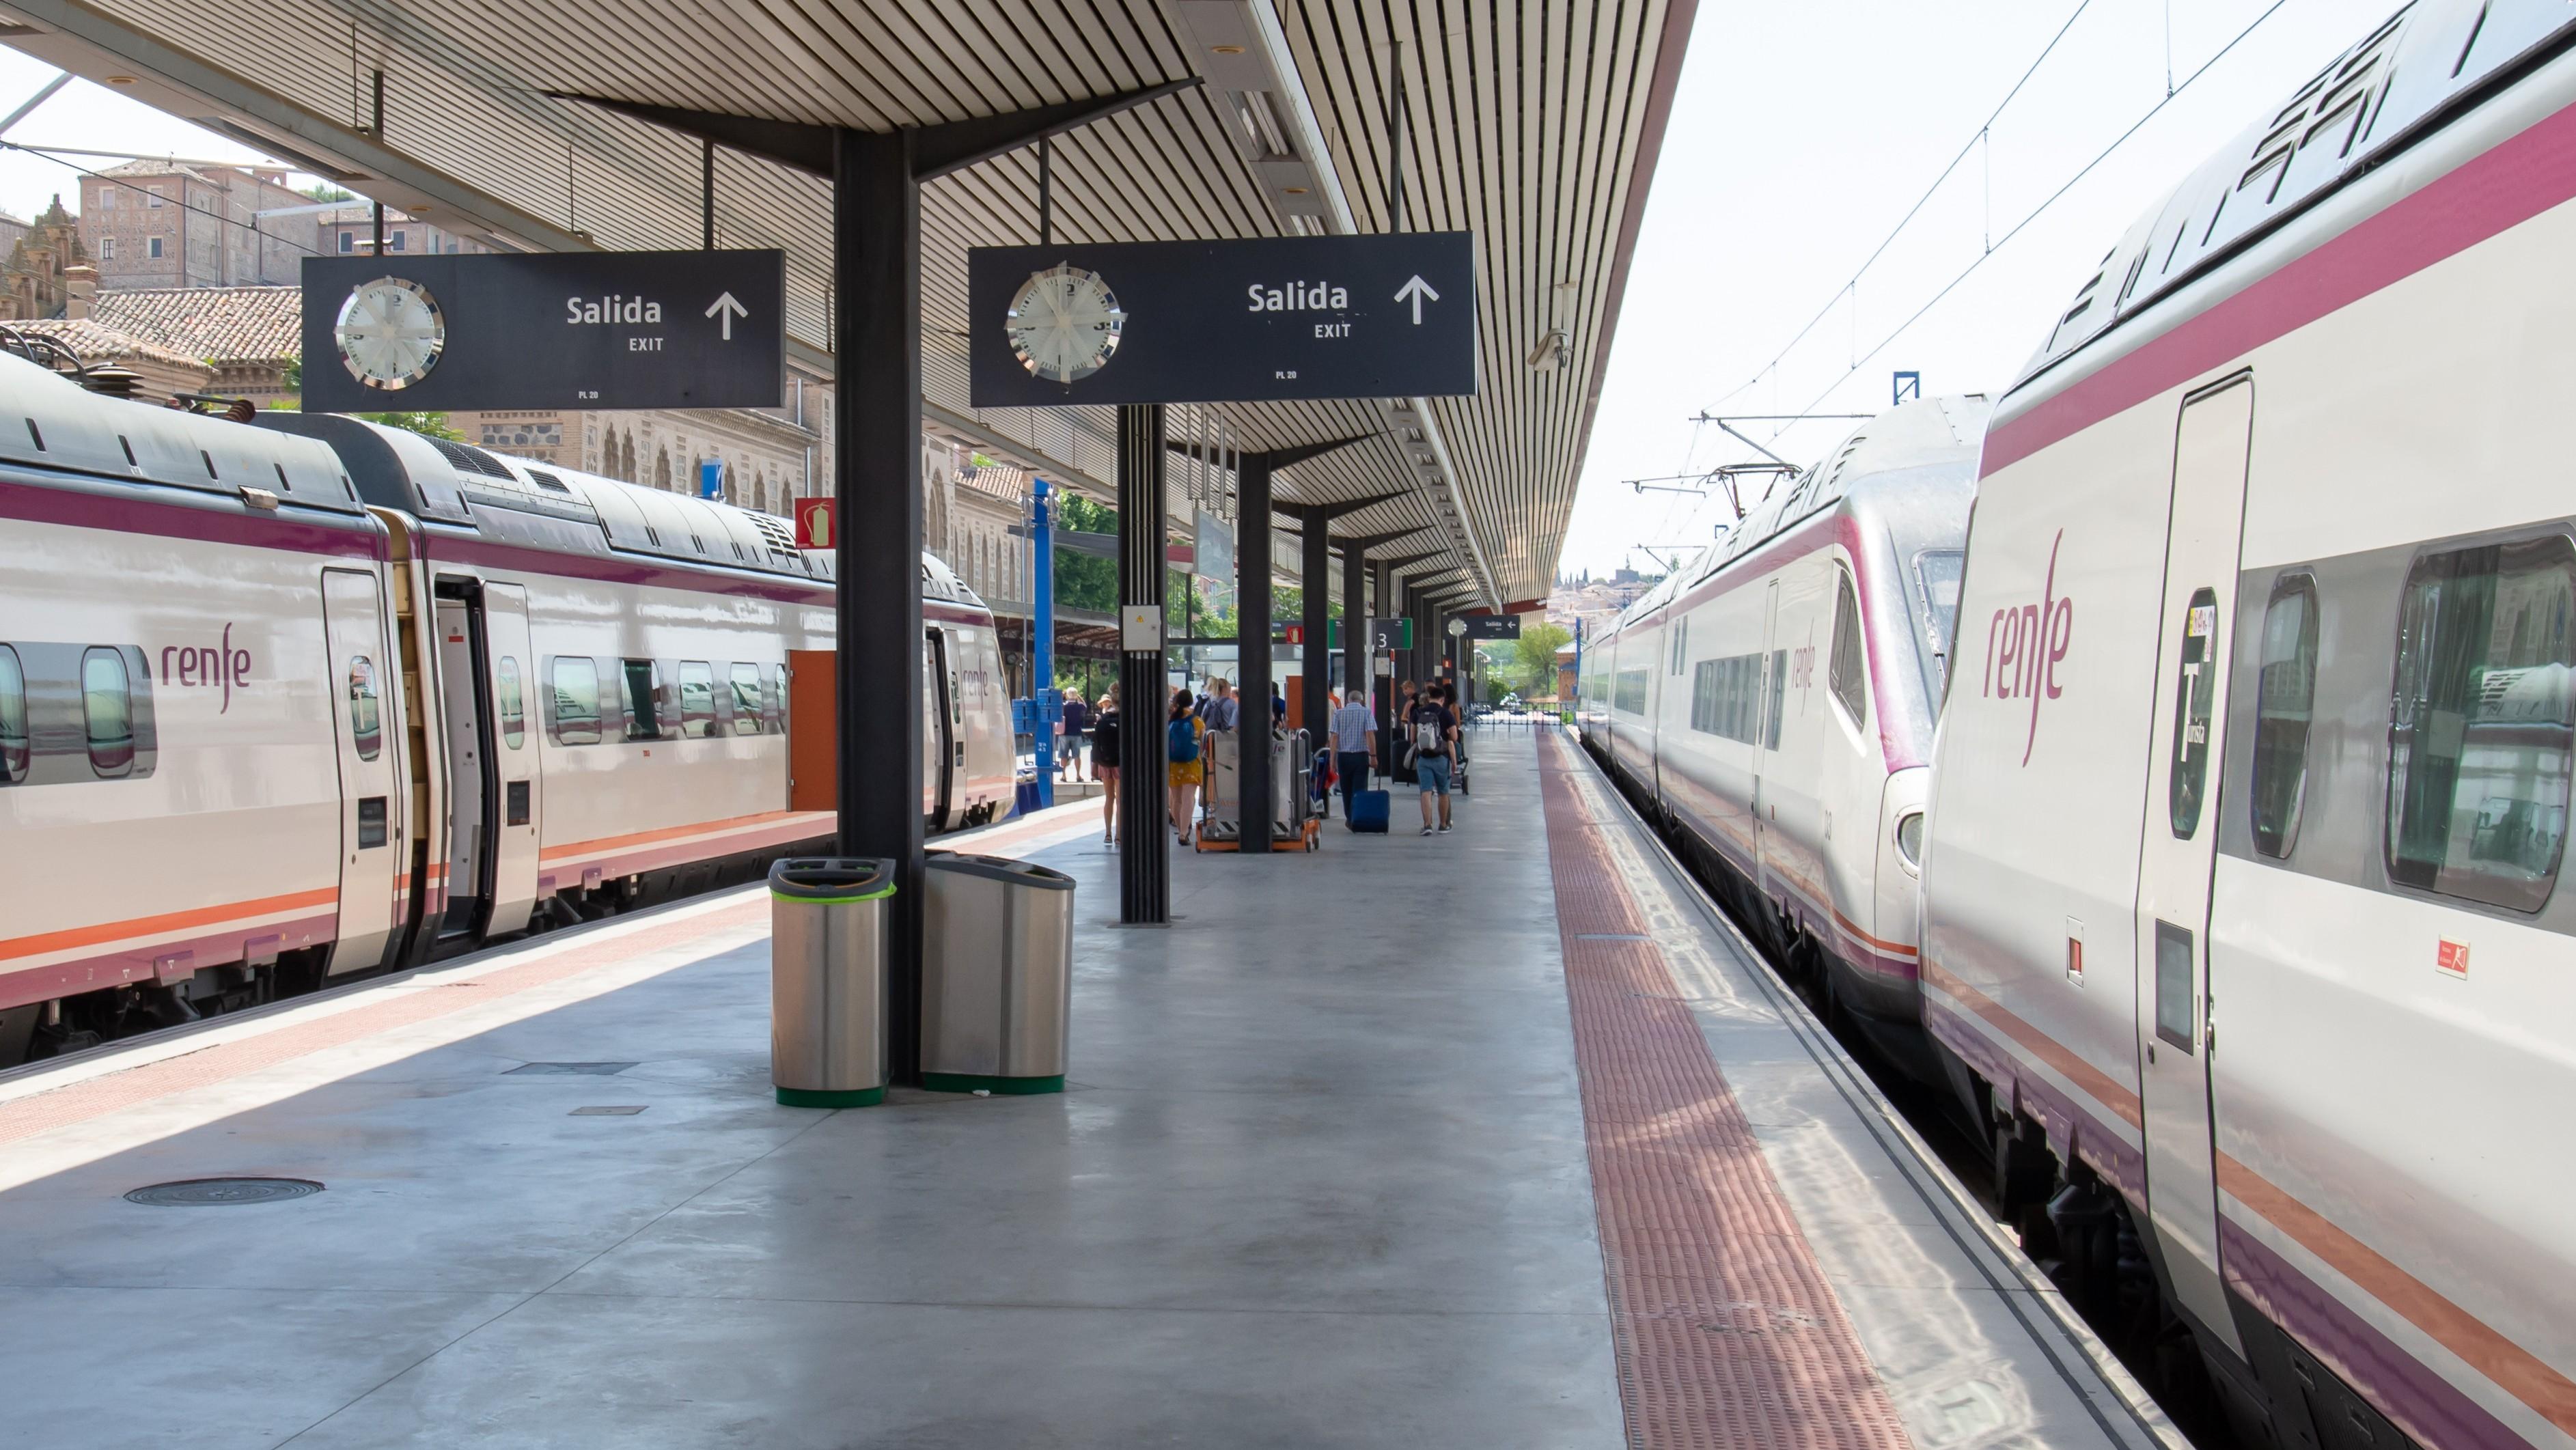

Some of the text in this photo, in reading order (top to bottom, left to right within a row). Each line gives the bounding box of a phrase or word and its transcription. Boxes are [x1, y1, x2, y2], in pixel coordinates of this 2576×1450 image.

[567, 294, 661, 324] Salida
[1248, 280, 1348, 311] Salida
[629, 337, 664, 352] EXIT
[1315, 324, 1351, 338] EXIT
[1276, 371, 1297, 379] PL 20
[579, 391, 599, 399] PL 20
[1379, 632, 1387, 648] 3
[1983, 527, 2073, 768] renfe
[161, 622, 251, 714] renfe
[1791, 617, 1816, 717] renfe
[963, 654, 988, 714] renfe
